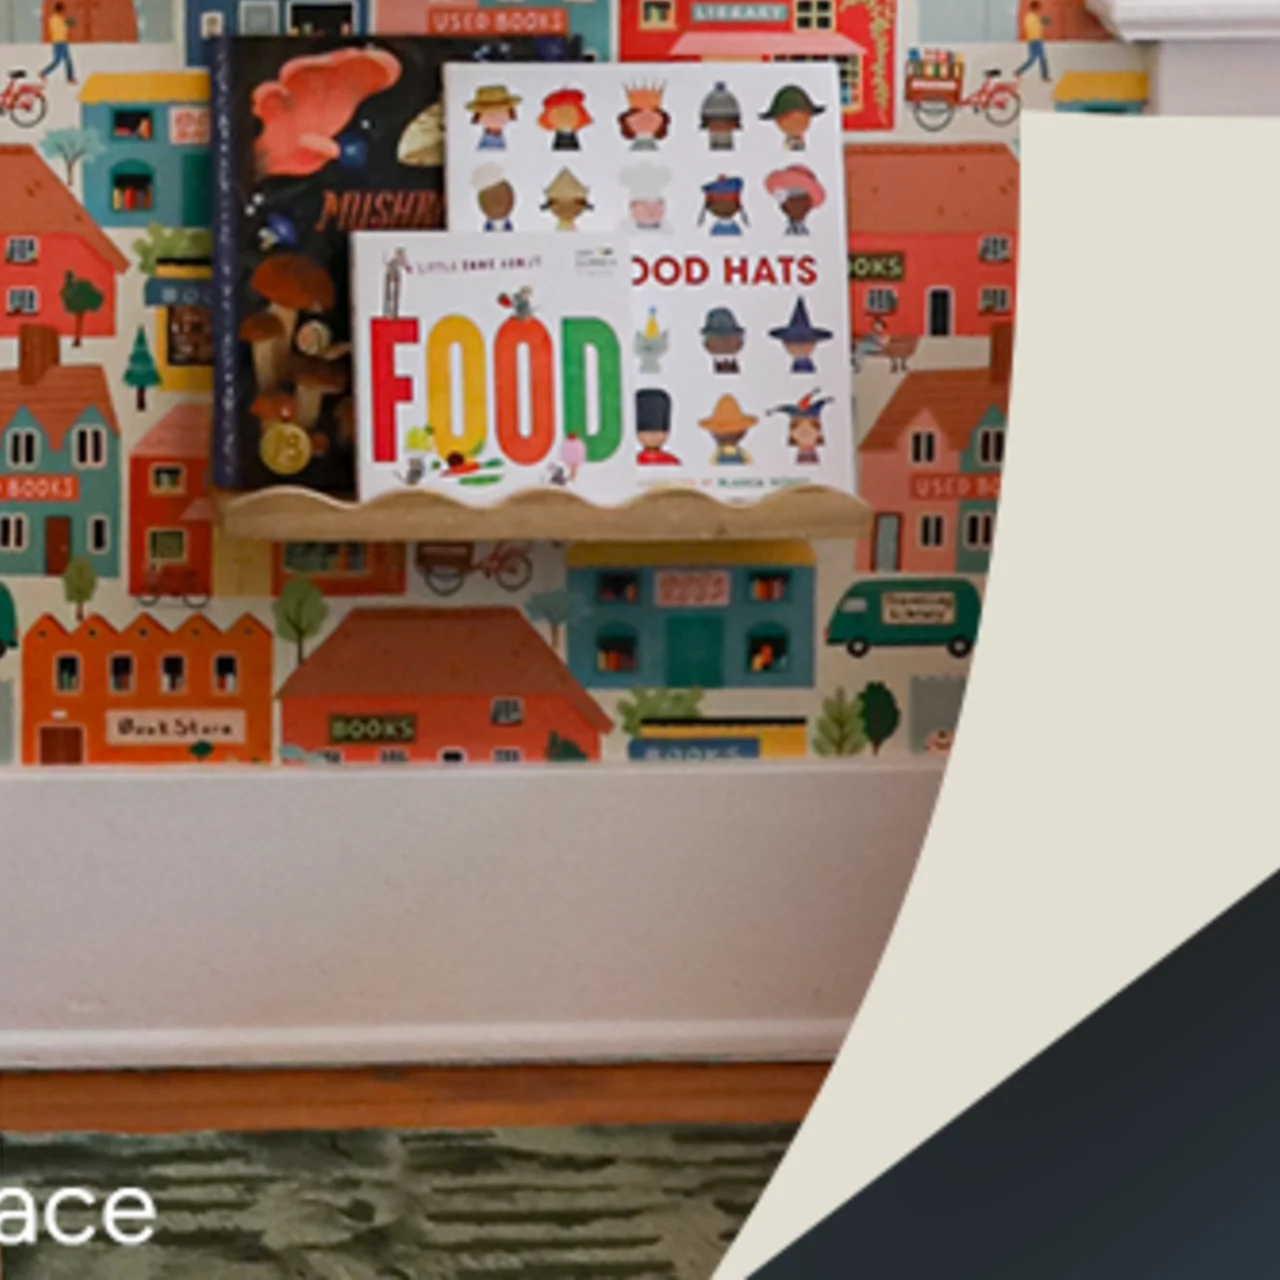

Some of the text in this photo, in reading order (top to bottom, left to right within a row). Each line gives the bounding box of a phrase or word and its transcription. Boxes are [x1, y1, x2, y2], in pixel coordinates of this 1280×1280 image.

[432, 7, 563, 31] USED BOOKS
[695, 4, 782, 20] LIBRARY
[723, 255, 818, 286] HATS
[370, 314, 623, 466] FOOD
[116, 718, 235, 737] Book Store
[332, 719, 415, 737] BOOKS
